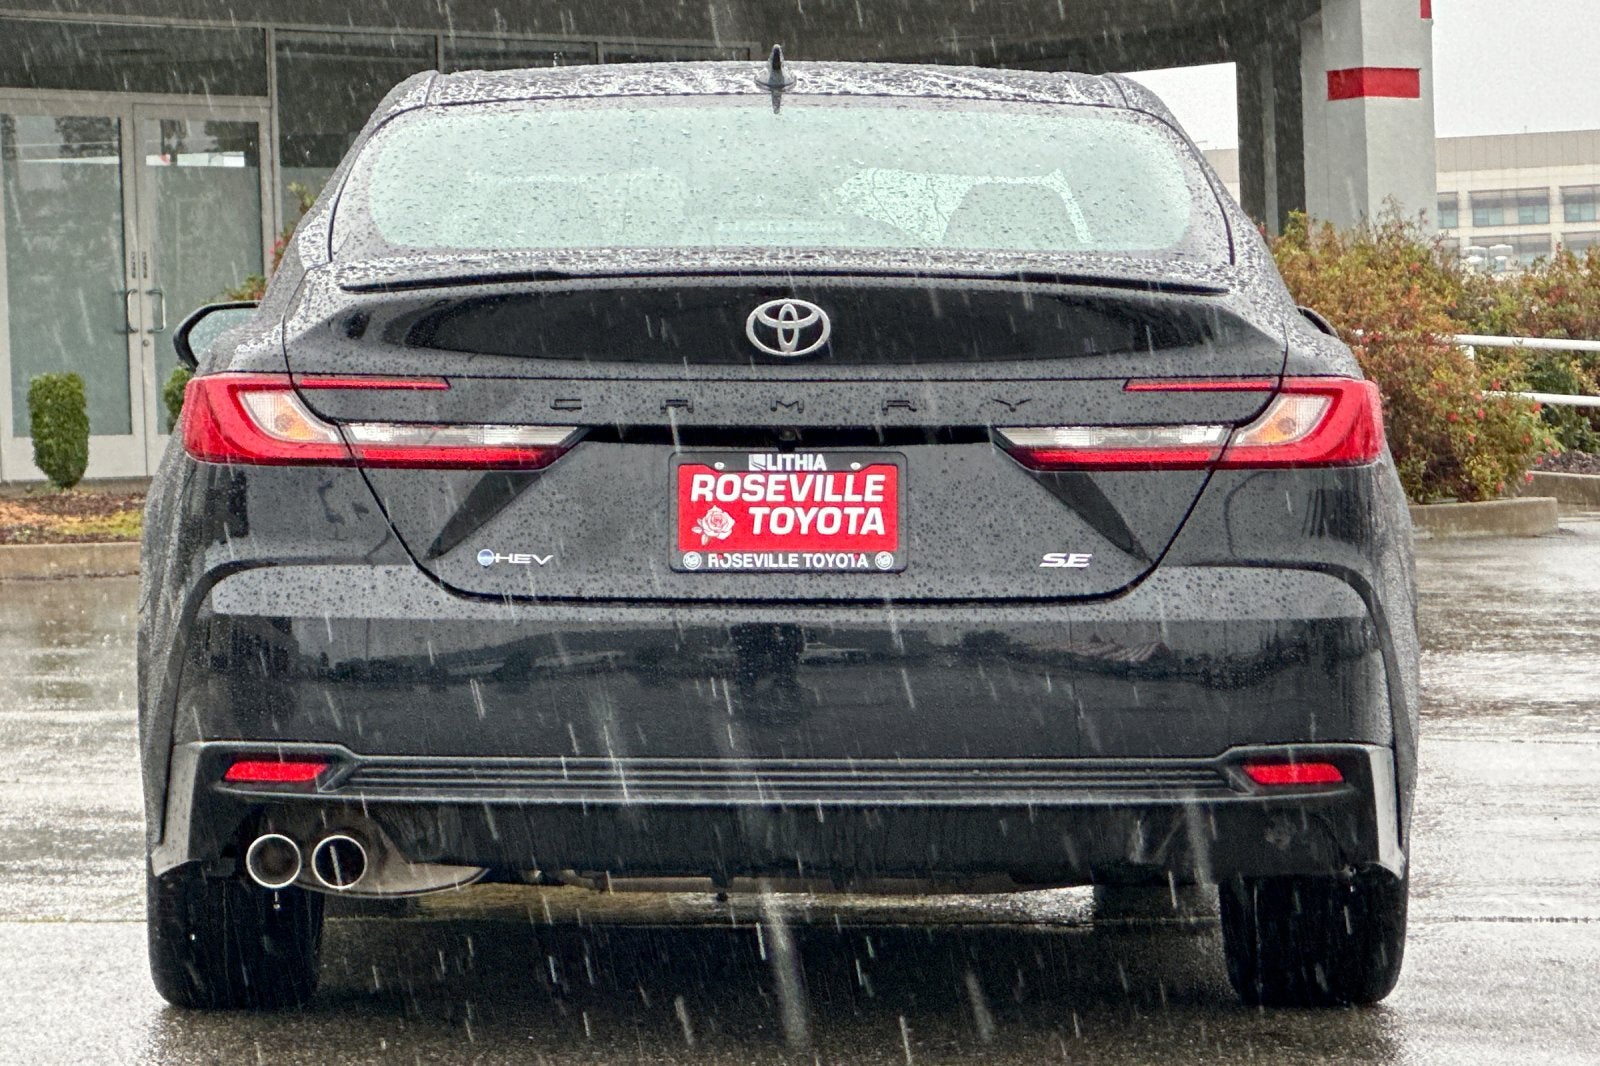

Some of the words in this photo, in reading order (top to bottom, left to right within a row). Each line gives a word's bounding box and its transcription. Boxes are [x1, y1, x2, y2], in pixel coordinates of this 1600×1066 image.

[550, 397, 1033, 414] CAMRY
[766, 453, 827, 471] LITHIA
[690, 473, 887, 502] ROSEVILLE
[748, 506, 886, 536] TOYOTA
[707, 552, 800, 568] ROSEVILLE
[802, 552, 869, 568] TOYOTA
[1039, 552, 1093, 568] SE
